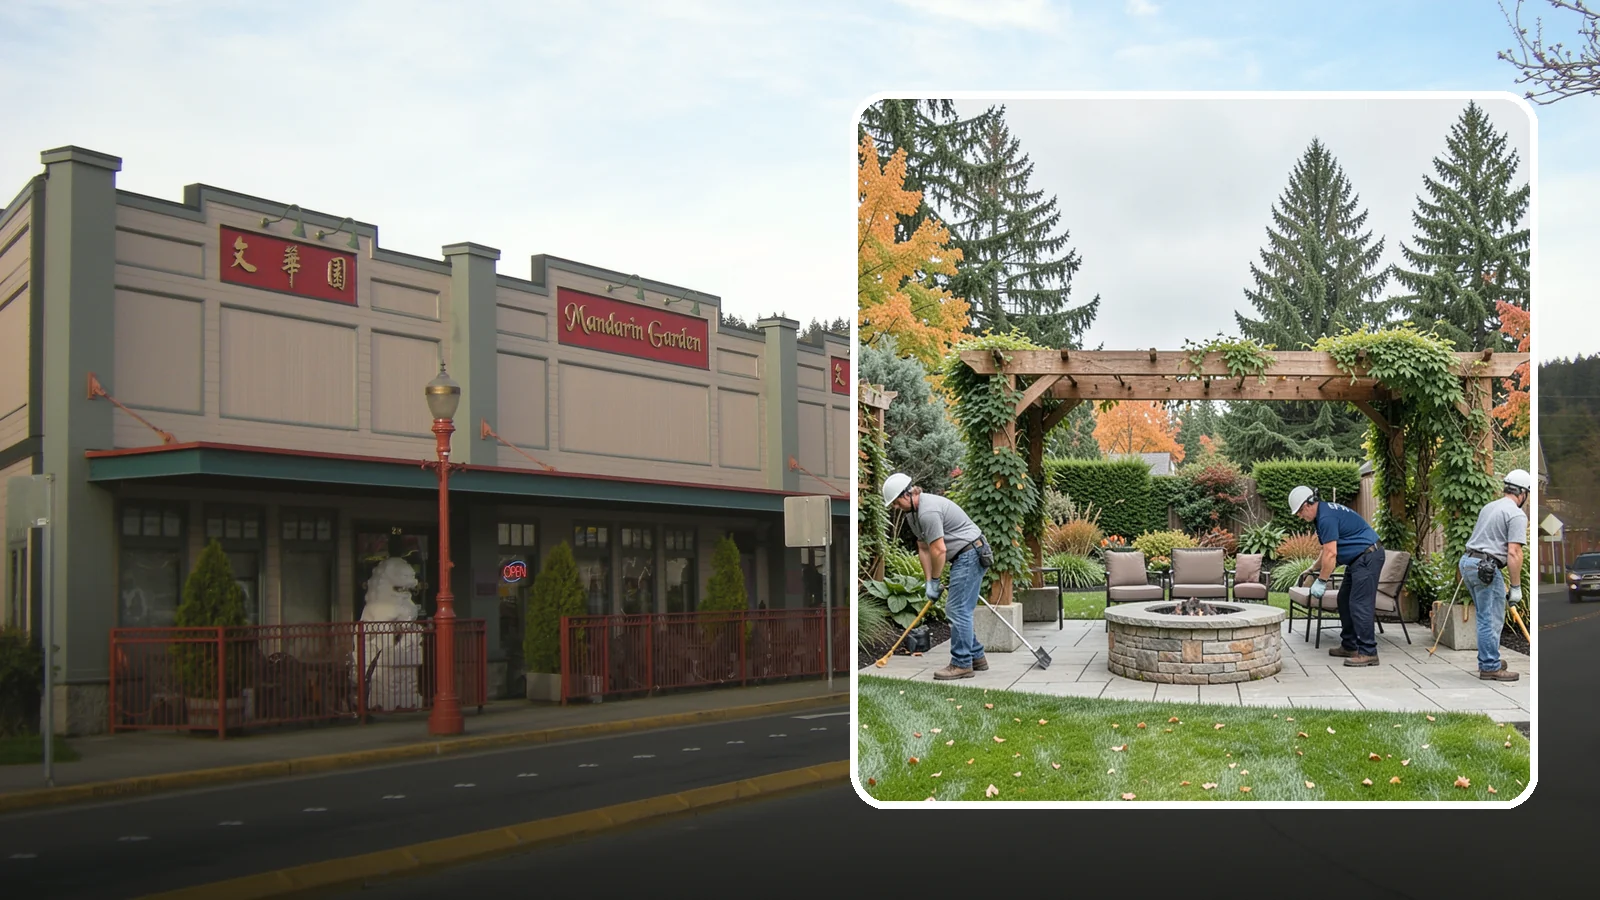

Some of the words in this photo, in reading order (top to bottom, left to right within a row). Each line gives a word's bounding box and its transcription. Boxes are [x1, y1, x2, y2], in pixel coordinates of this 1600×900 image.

[565, 302, 644, 341] Mandarin
[648, 321, 701, 352] Garden
[503, 565, 527, 578] OPEN
